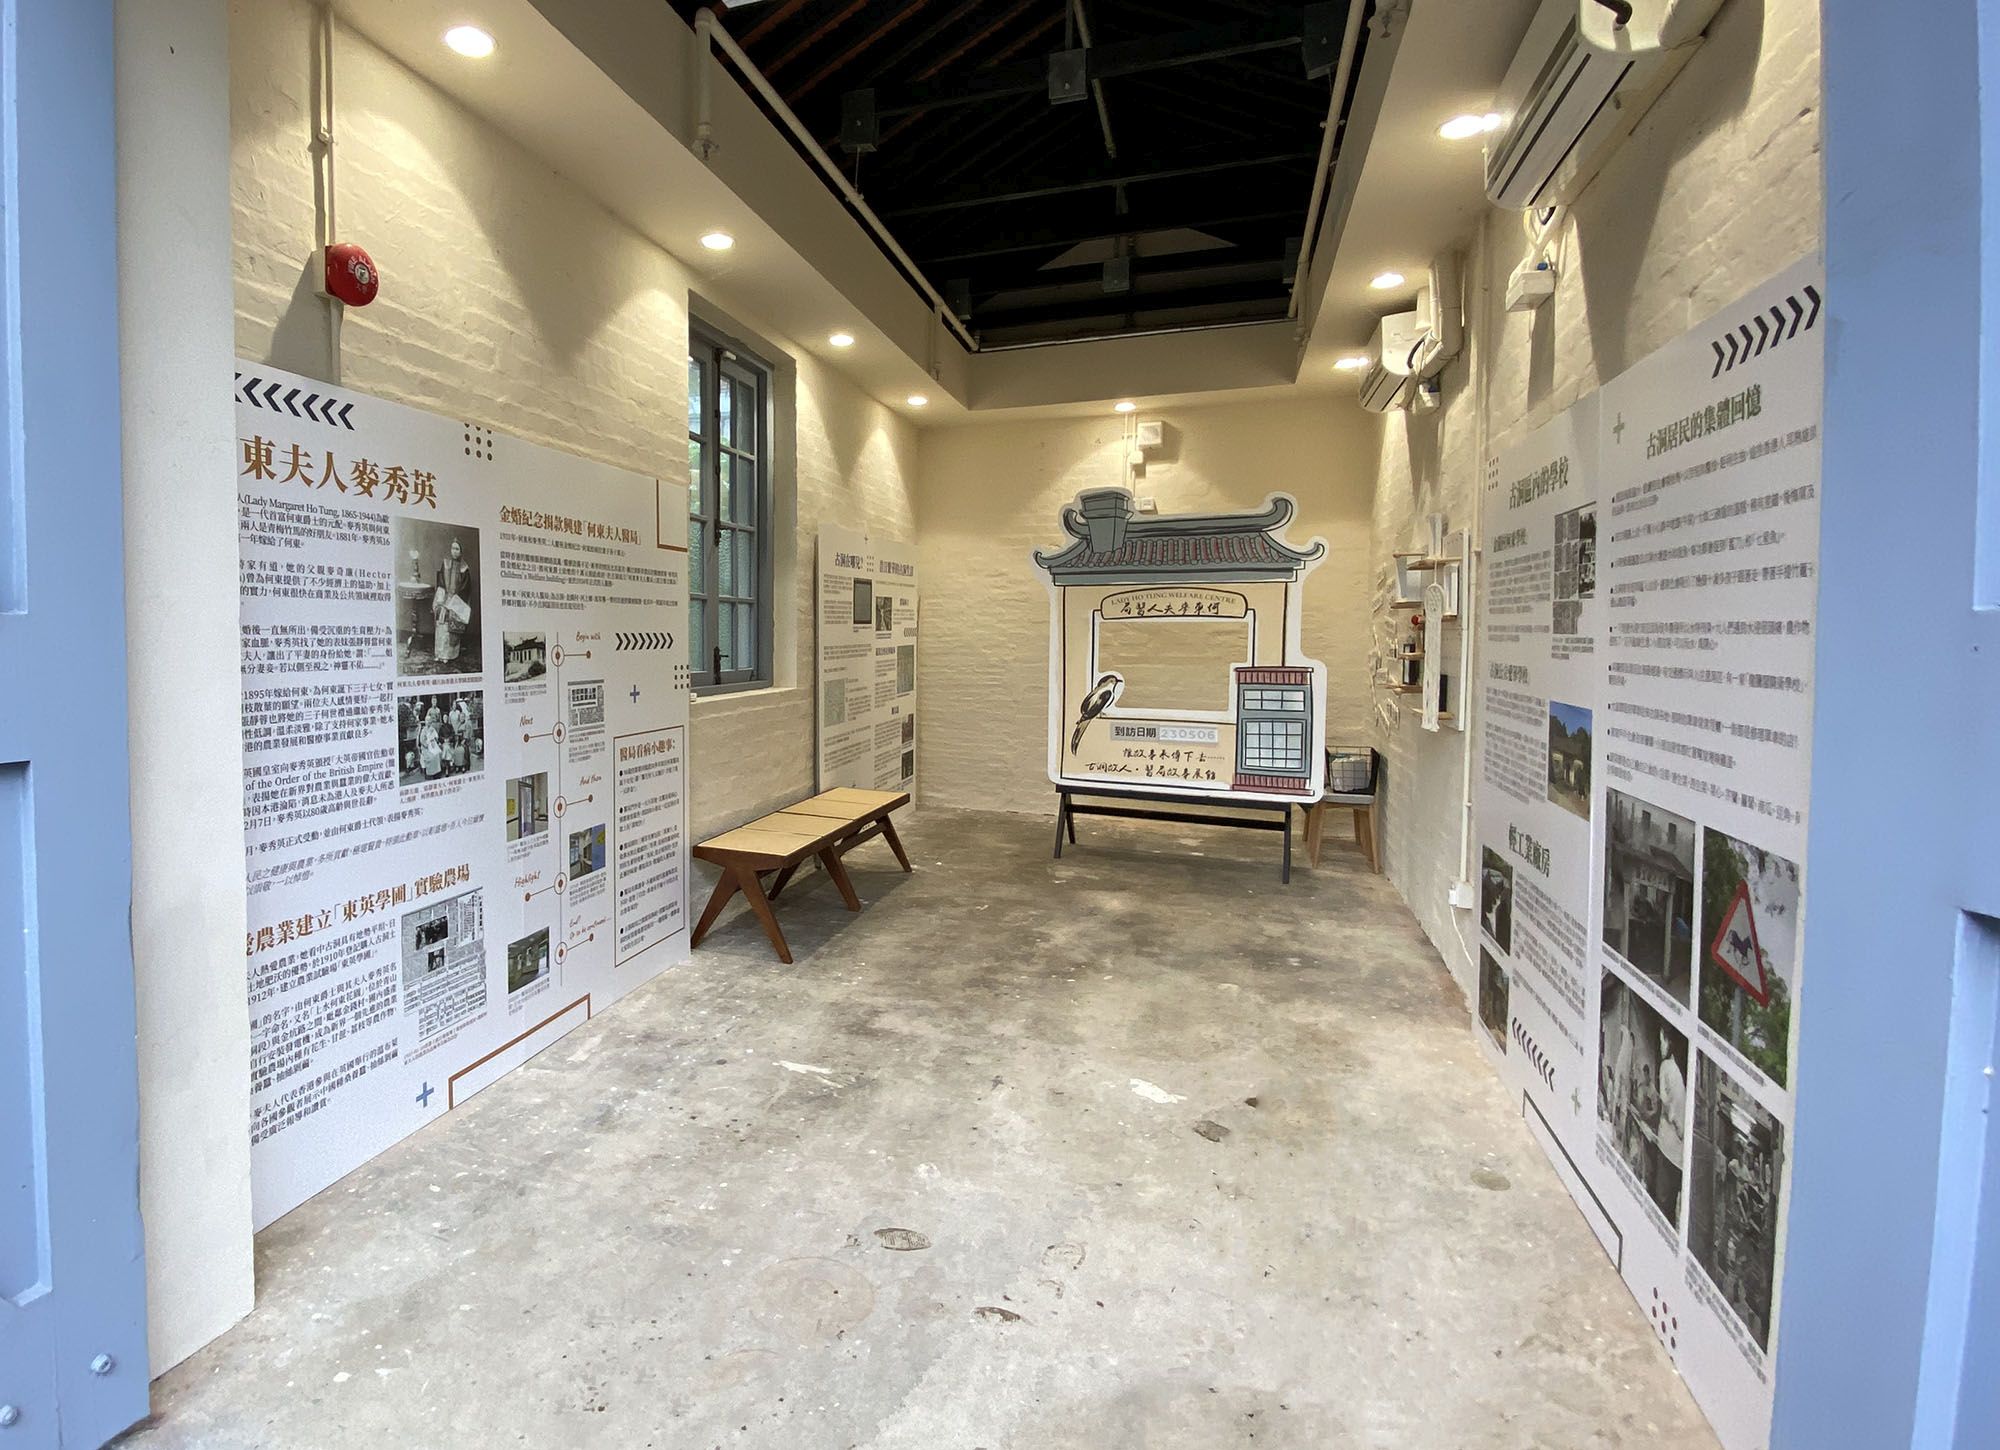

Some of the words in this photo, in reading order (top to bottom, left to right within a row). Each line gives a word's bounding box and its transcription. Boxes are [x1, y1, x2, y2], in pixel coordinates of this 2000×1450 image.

[1646, 383, 1762, 460] 古洞居民的集體回憶
[240, 435, 437, 509] 東夫人麥秀英
[269, 498, 304, 512] Margaret
[306, 502, 318, 513] Ho
[318, 505, 340, 518] Tung,
[499, 505, 641, 546] 金婚紀念捐款興建「何東夫人醫局」
[1114, 726, 1157, 738] 到訪日期
[1160, 728, 1216, 740] 230506
[245, 778, 255, 791] of
[257, 777, 273, 789] the
[274, 773, 300, 787] Order
[302, 771, 311, 782] of
[313, 769, 327, 780] the
[329, 764, 355, 777] British
[356, 761, 384, 775] Empire
